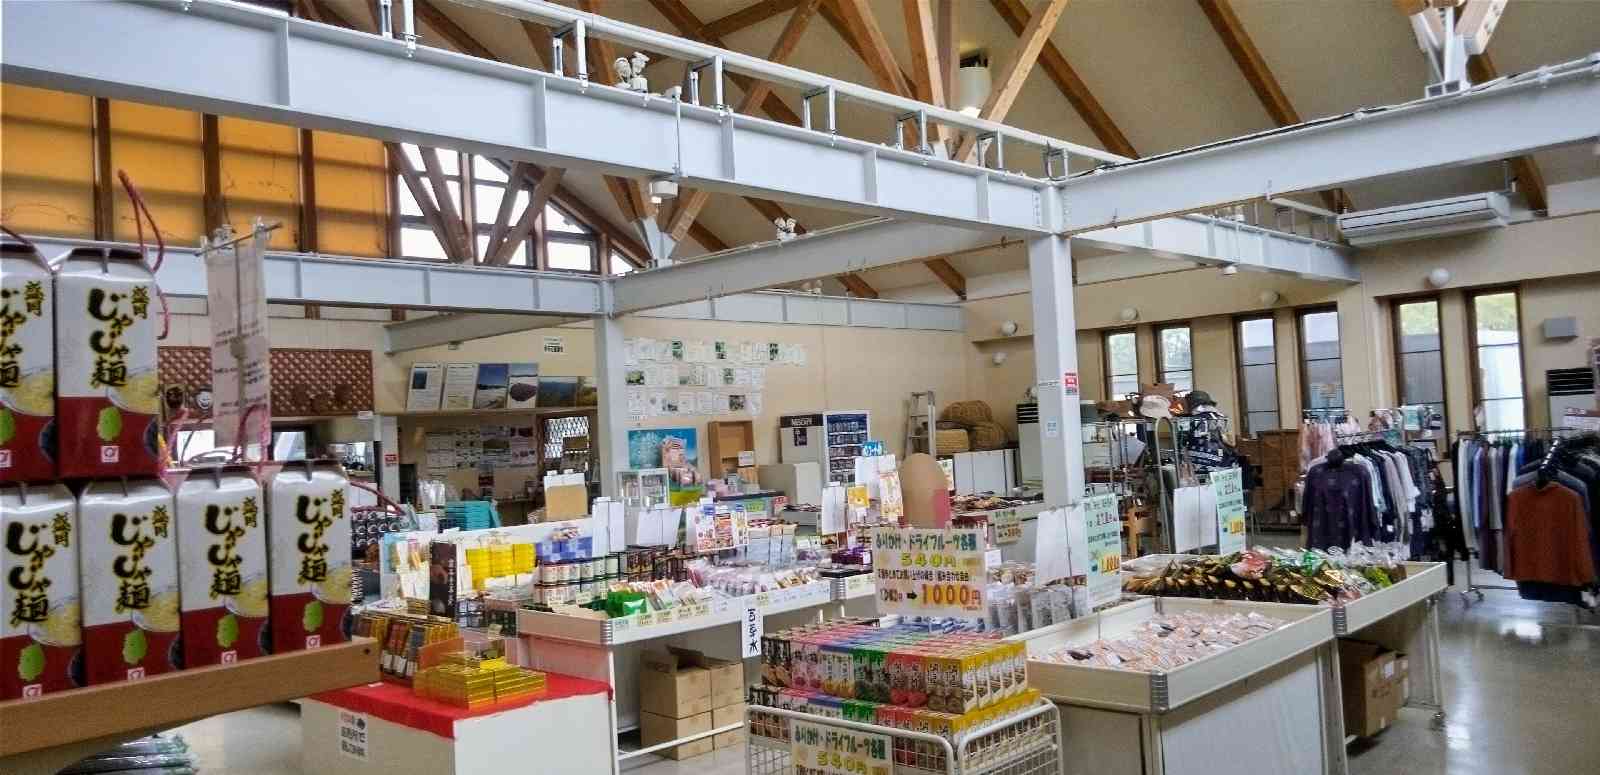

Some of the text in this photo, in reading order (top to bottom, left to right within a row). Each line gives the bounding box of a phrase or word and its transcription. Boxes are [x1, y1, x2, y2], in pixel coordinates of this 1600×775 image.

[88, 288, 133, 388] じゃじゃ麺
[6, 521, 55, 627] じゃじゃ麺
[111, 513, 154, 613] じゃじゃ麺
[205, 505, 245, 597] じゃじゃ麺
[297, 495, 332, 584] じゃじゃ麺
